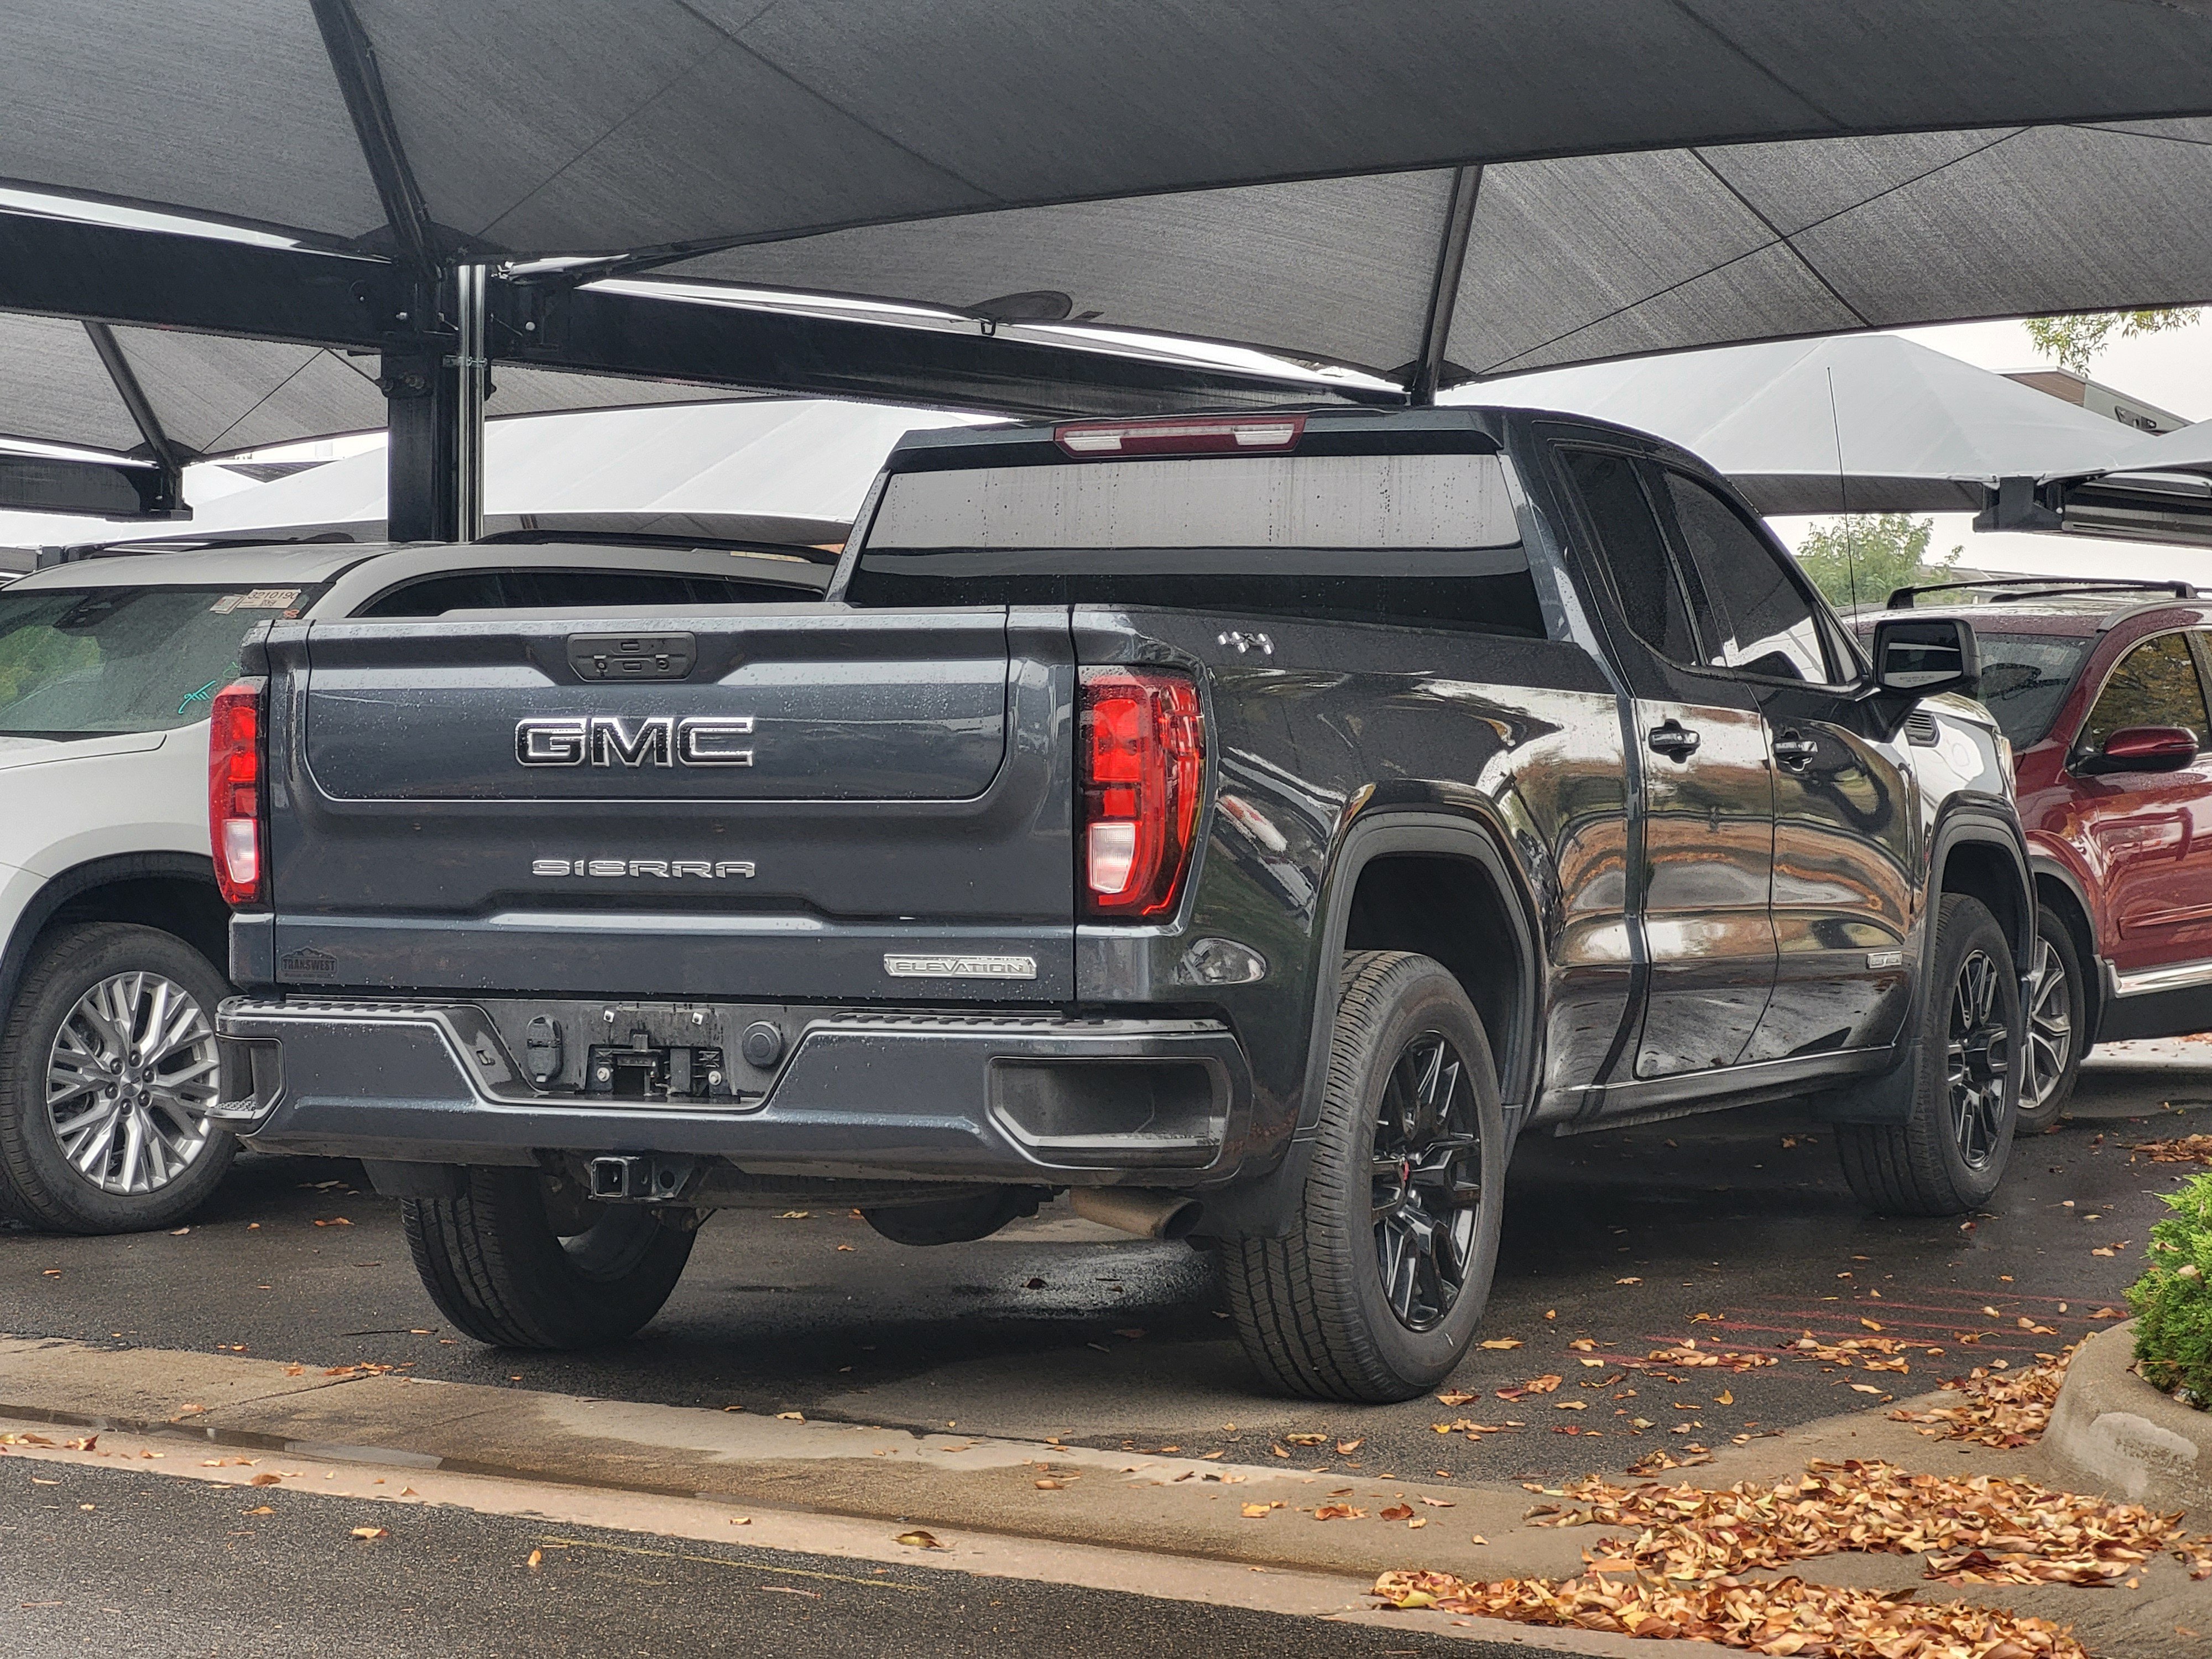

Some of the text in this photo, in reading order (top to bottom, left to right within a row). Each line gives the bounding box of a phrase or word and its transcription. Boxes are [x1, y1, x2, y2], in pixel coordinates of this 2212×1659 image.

[515, 717, 754, 767] GMC
[532, 860, 757, 878] SIERRA
[283, 958, 335, 971] TRANSWEST
[895, 961, 1024, 973] ELEVATION
